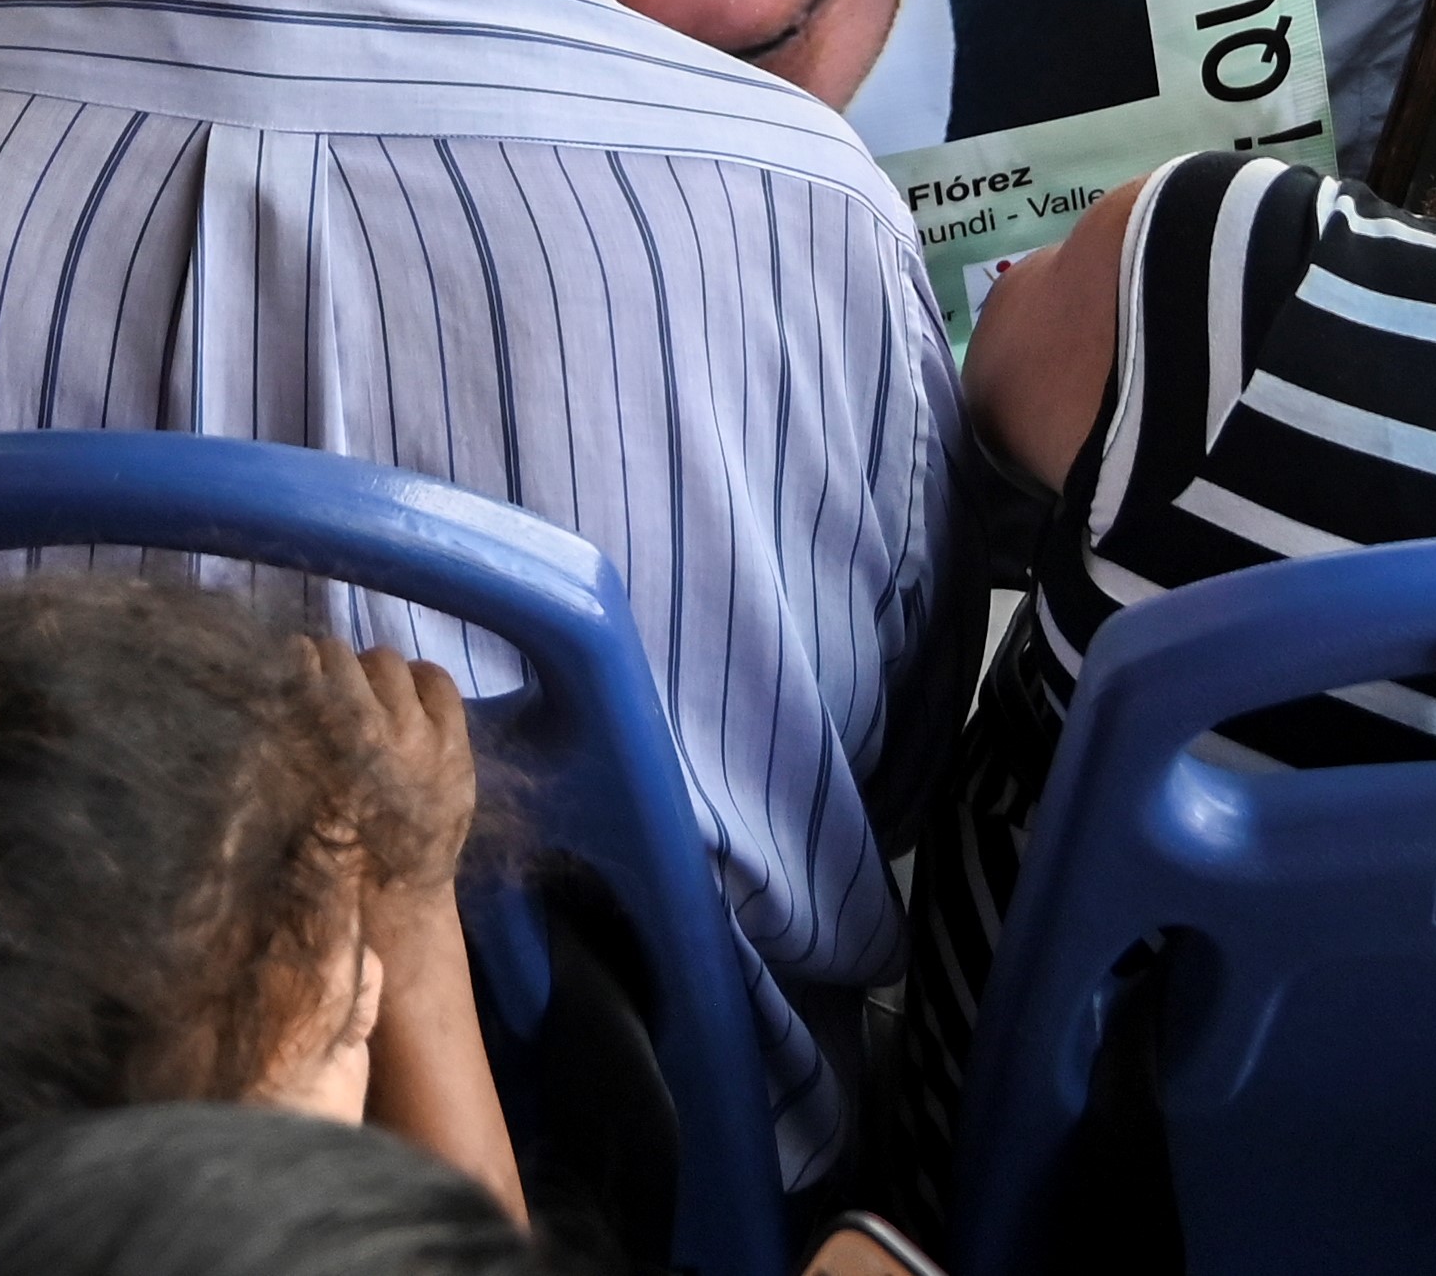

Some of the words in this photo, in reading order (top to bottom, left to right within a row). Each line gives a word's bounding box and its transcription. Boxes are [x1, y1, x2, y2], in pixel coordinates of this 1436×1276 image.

[908, 166, 1033, 212] Flórez
[919, 207, 996, 246] undi
[1027, 187, 1105, 219] Valle
